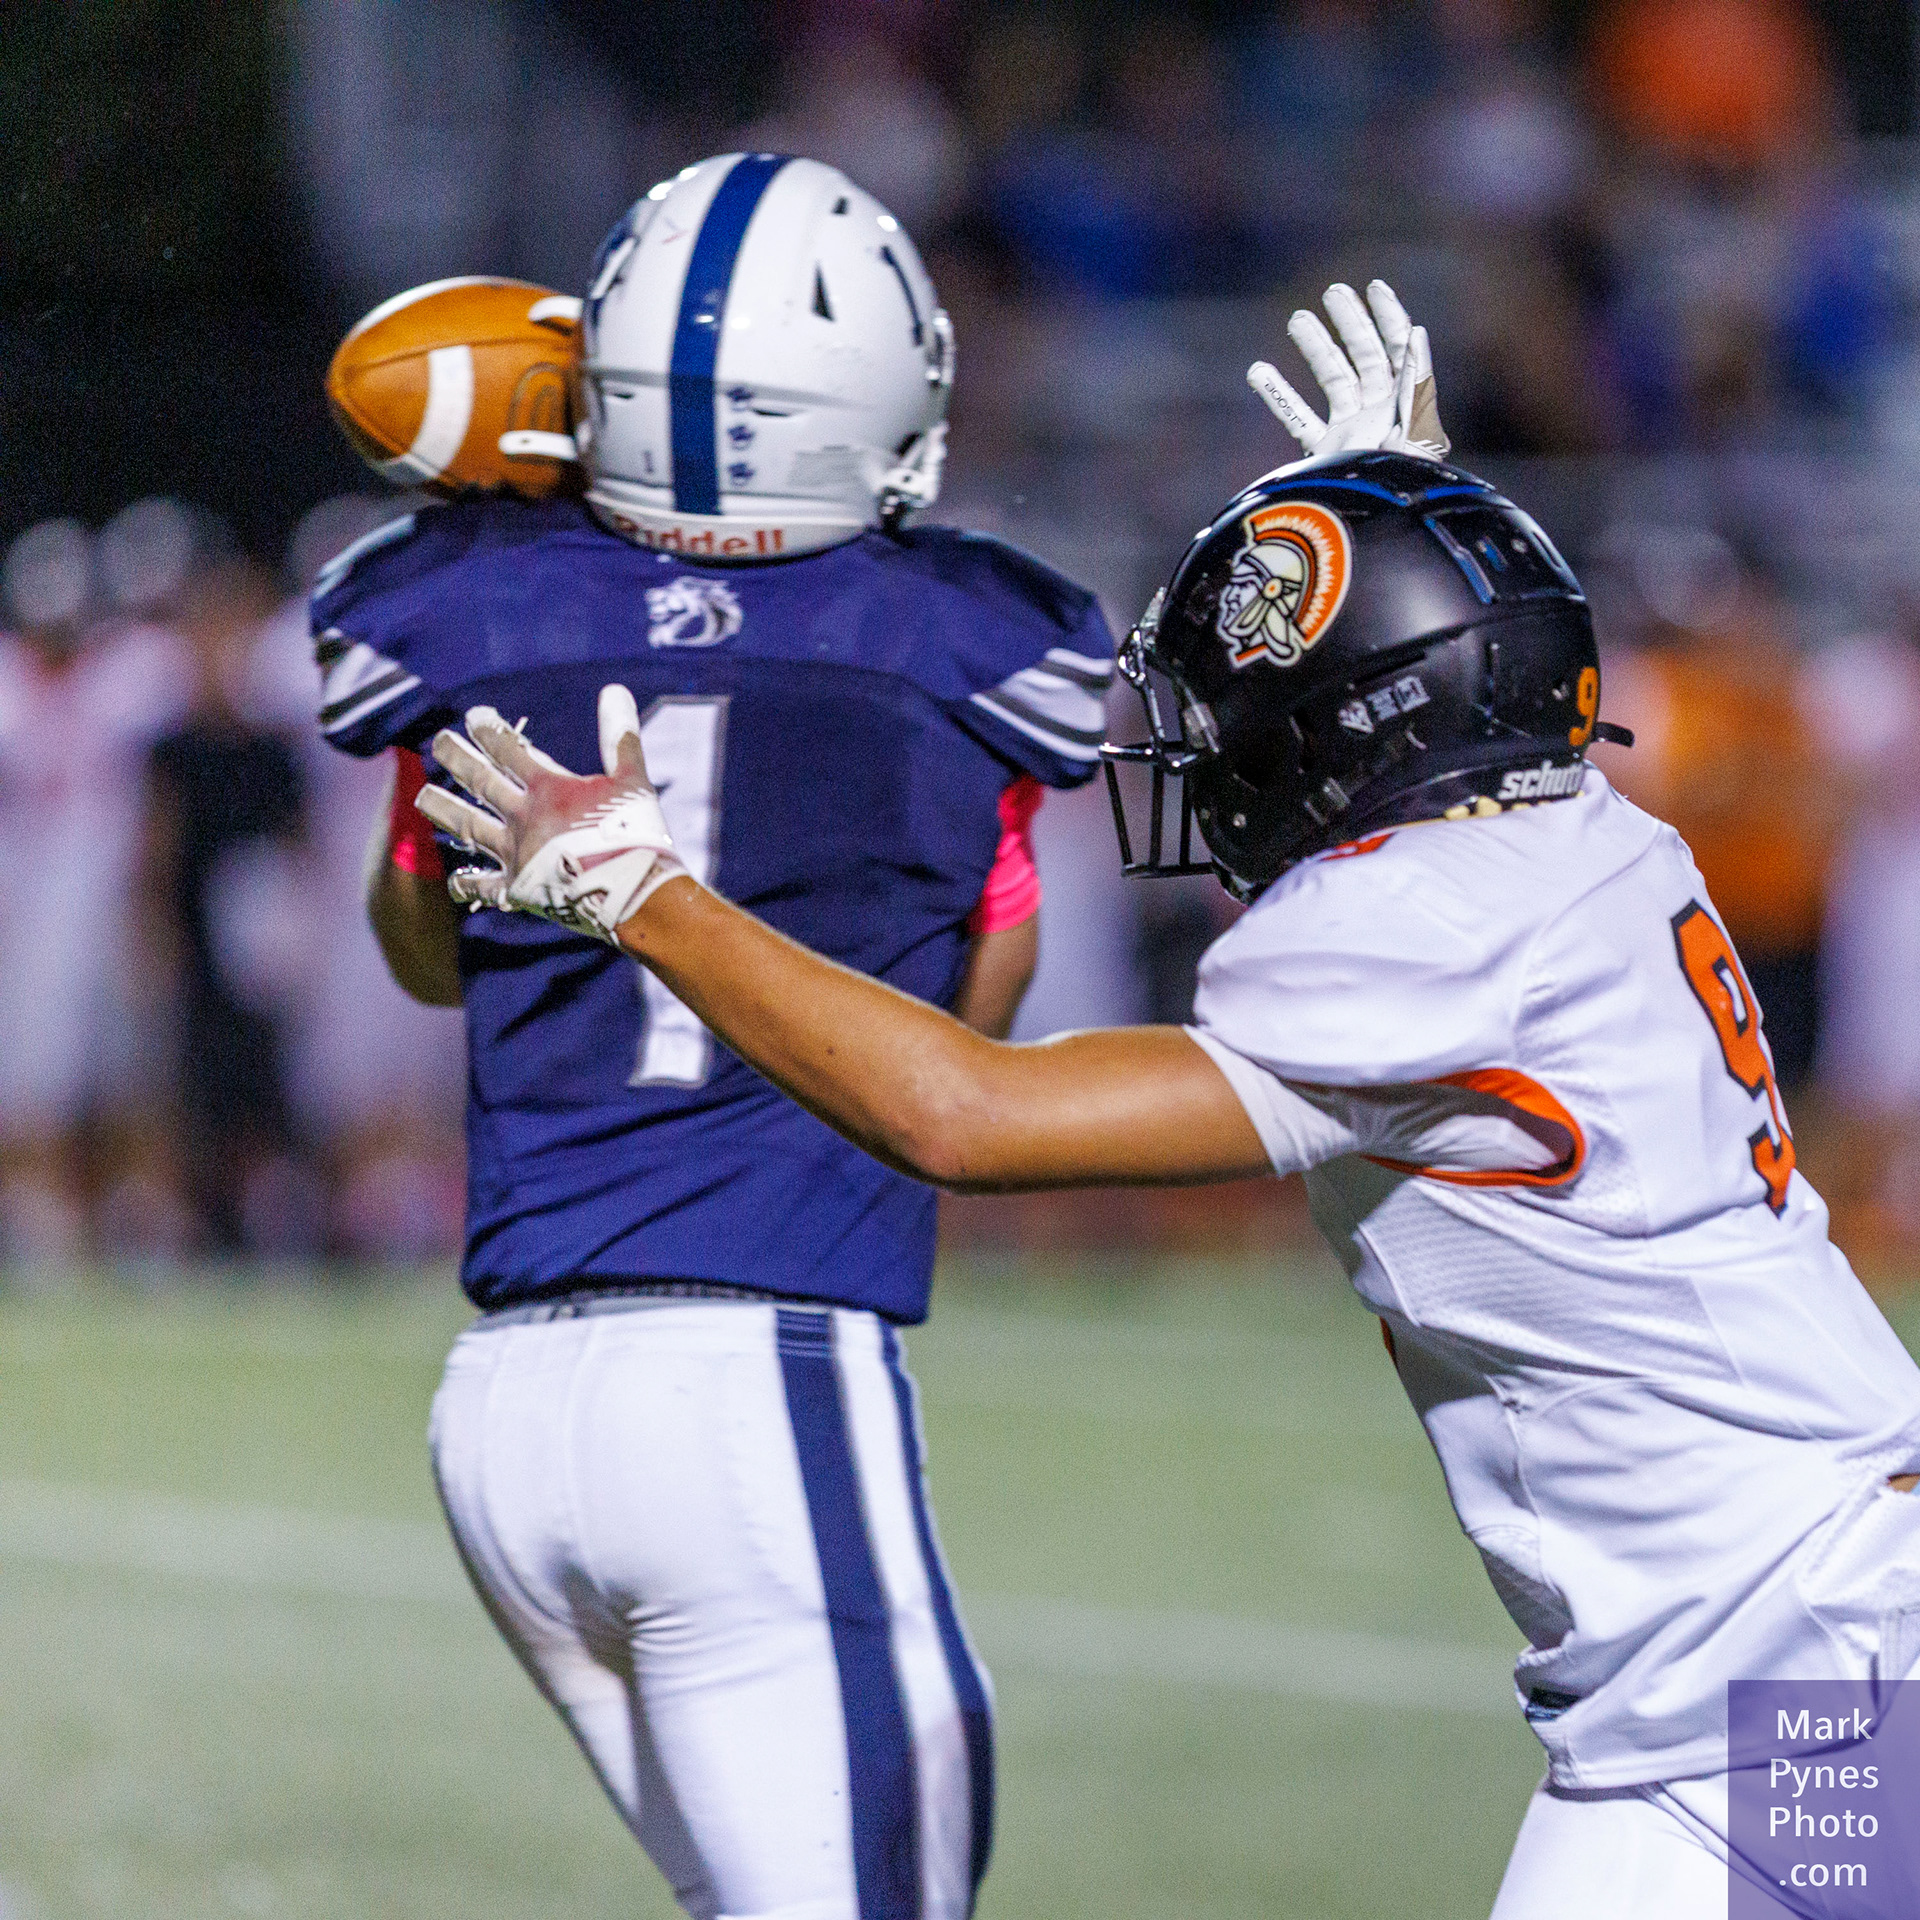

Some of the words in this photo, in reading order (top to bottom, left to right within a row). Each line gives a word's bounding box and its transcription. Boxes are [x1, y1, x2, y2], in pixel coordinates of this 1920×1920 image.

[1568, 667, 1598, 746] 9
[628, 694, 731, 1089] 1
[1670, 897, 1797, 1220] 9
